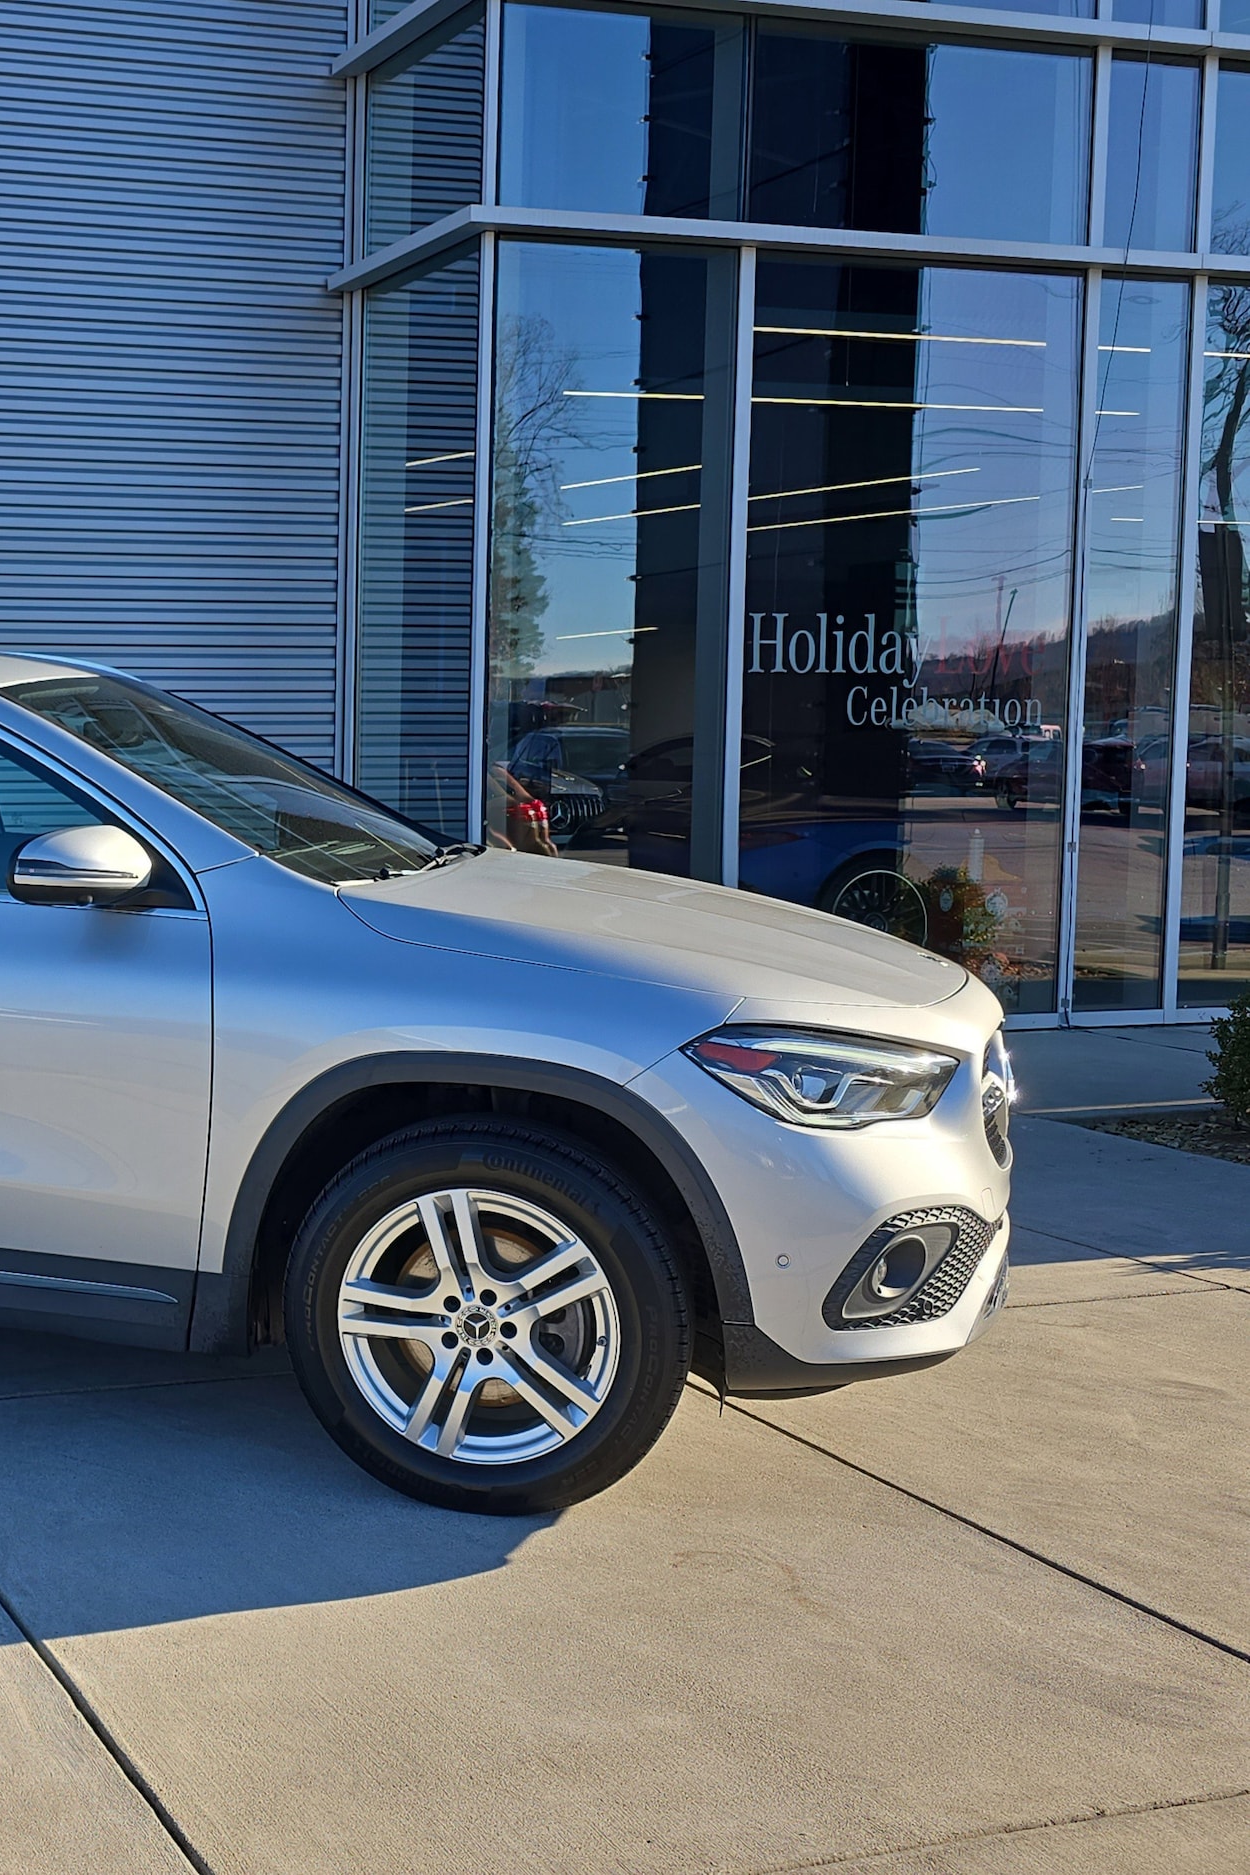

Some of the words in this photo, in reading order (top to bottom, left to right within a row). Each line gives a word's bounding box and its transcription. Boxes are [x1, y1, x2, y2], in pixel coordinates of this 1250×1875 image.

[748, 612, 931, 688] Holiday
[847, 686, 1043, 727] Celebration
[482, 1151, 591, 1208] Continental
